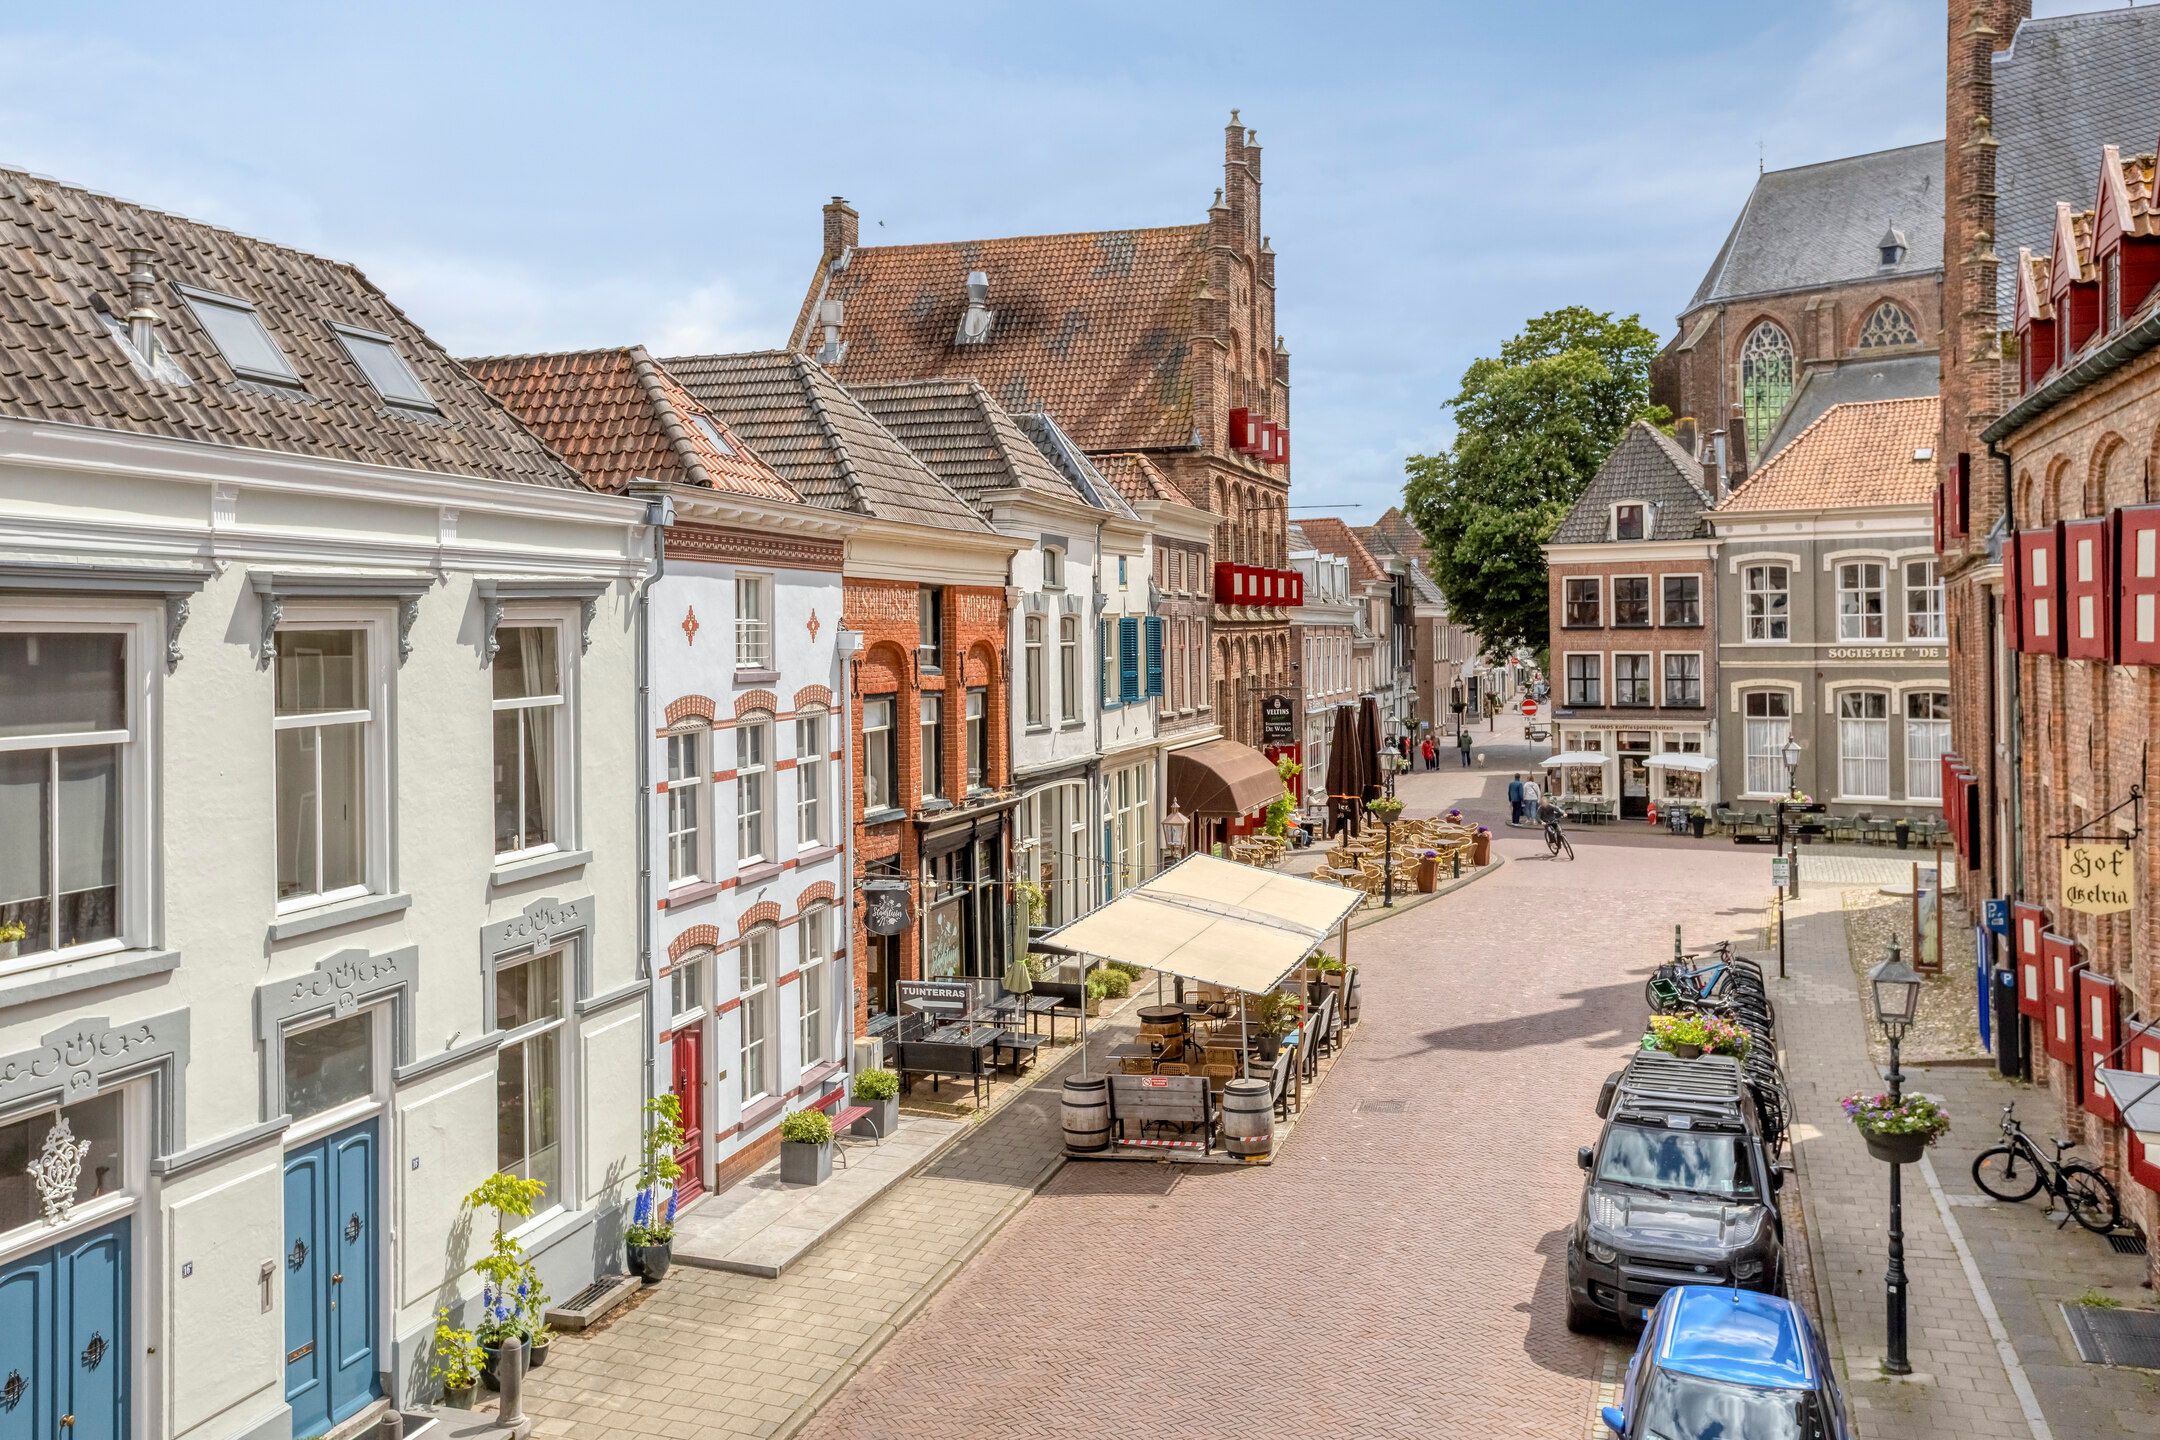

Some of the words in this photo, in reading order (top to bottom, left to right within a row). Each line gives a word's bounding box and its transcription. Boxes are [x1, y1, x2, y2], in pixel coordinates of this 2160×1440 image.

[1266, 708, 1290, 716] VELTINS
[2070, 848, 2124, 878] Hof
[2067, 884, 2128, 907] Gelria
[2003, 973, 2012, 985] P
[902, 987, 965, 998] TUINTERRAS
